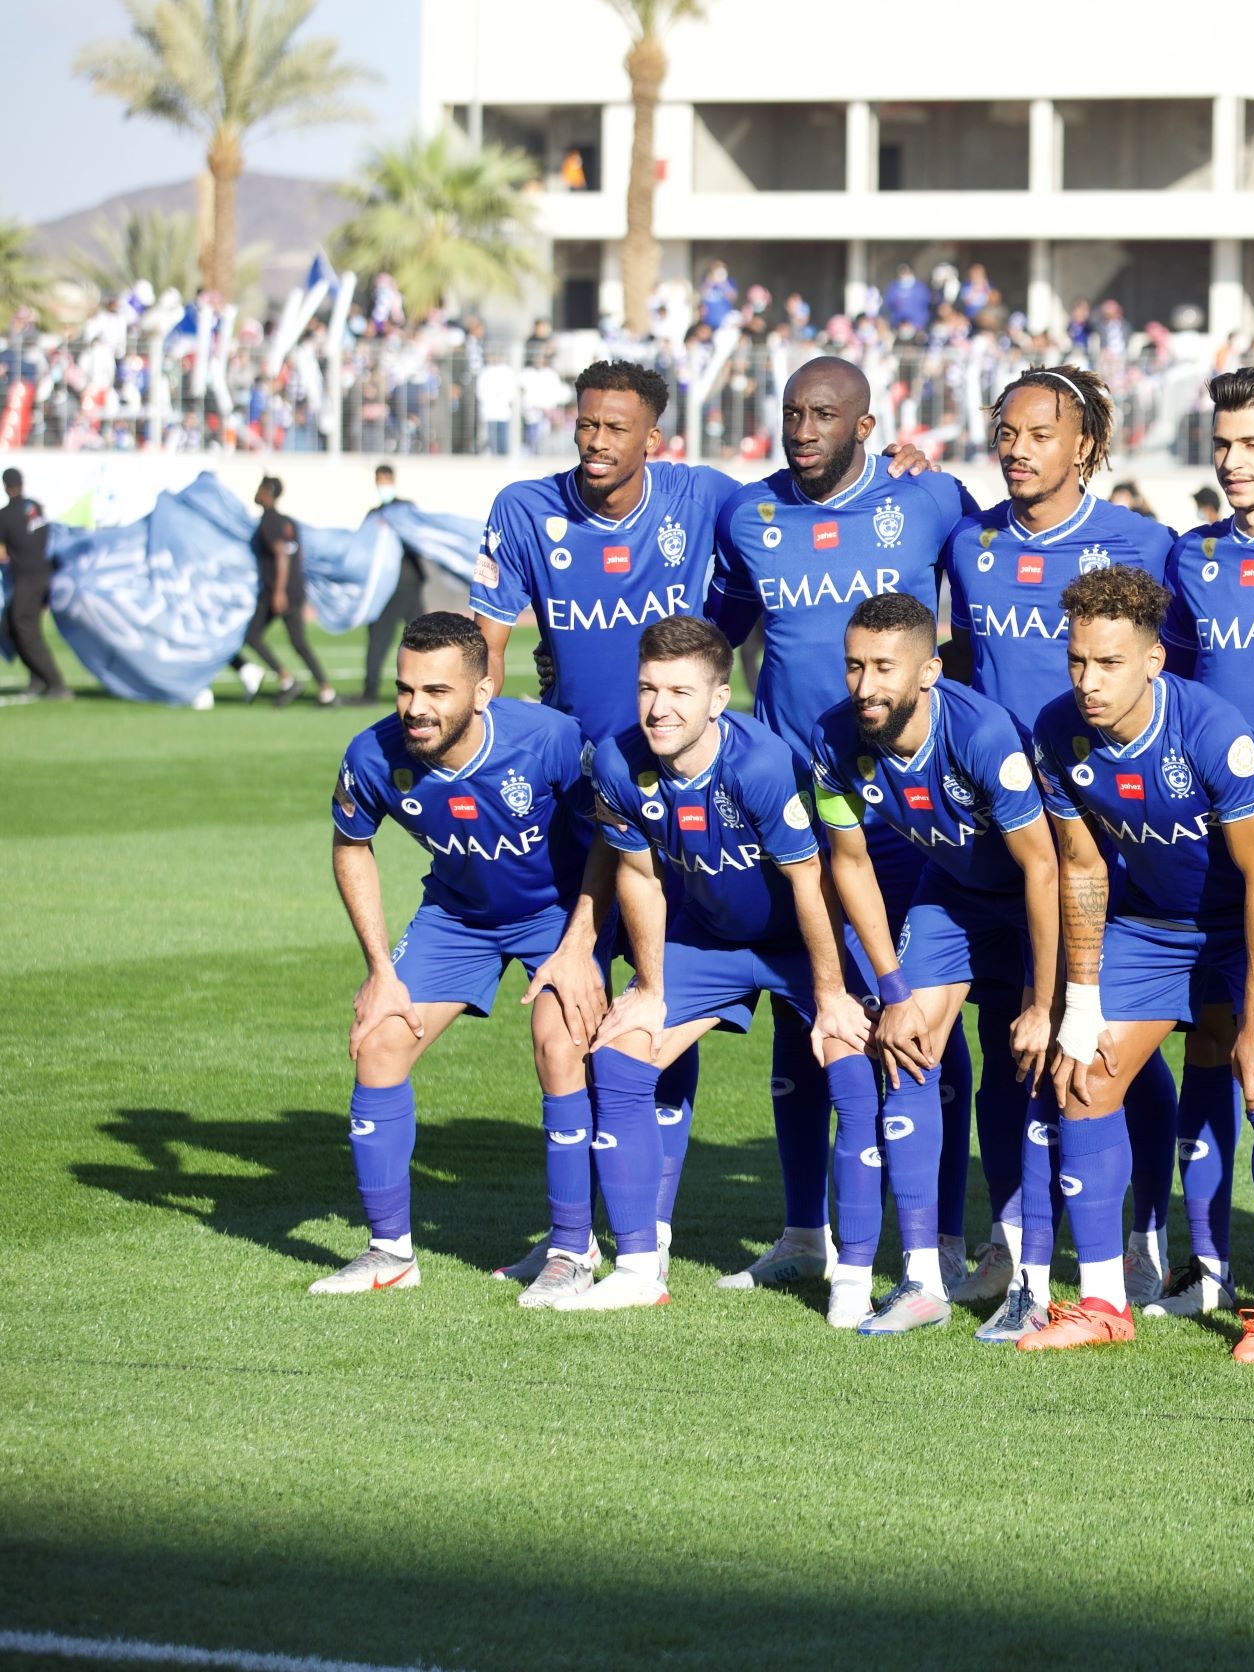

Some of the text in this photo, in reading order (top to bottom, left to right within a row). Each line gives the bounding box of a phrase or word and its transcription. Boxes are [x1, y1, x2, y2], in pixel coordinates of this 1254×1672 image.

[547, 584, 690, 631] EMAAR
[758, 568, 900, 610] EMAAR
[1089, 810, 1221, 845] MAAR
